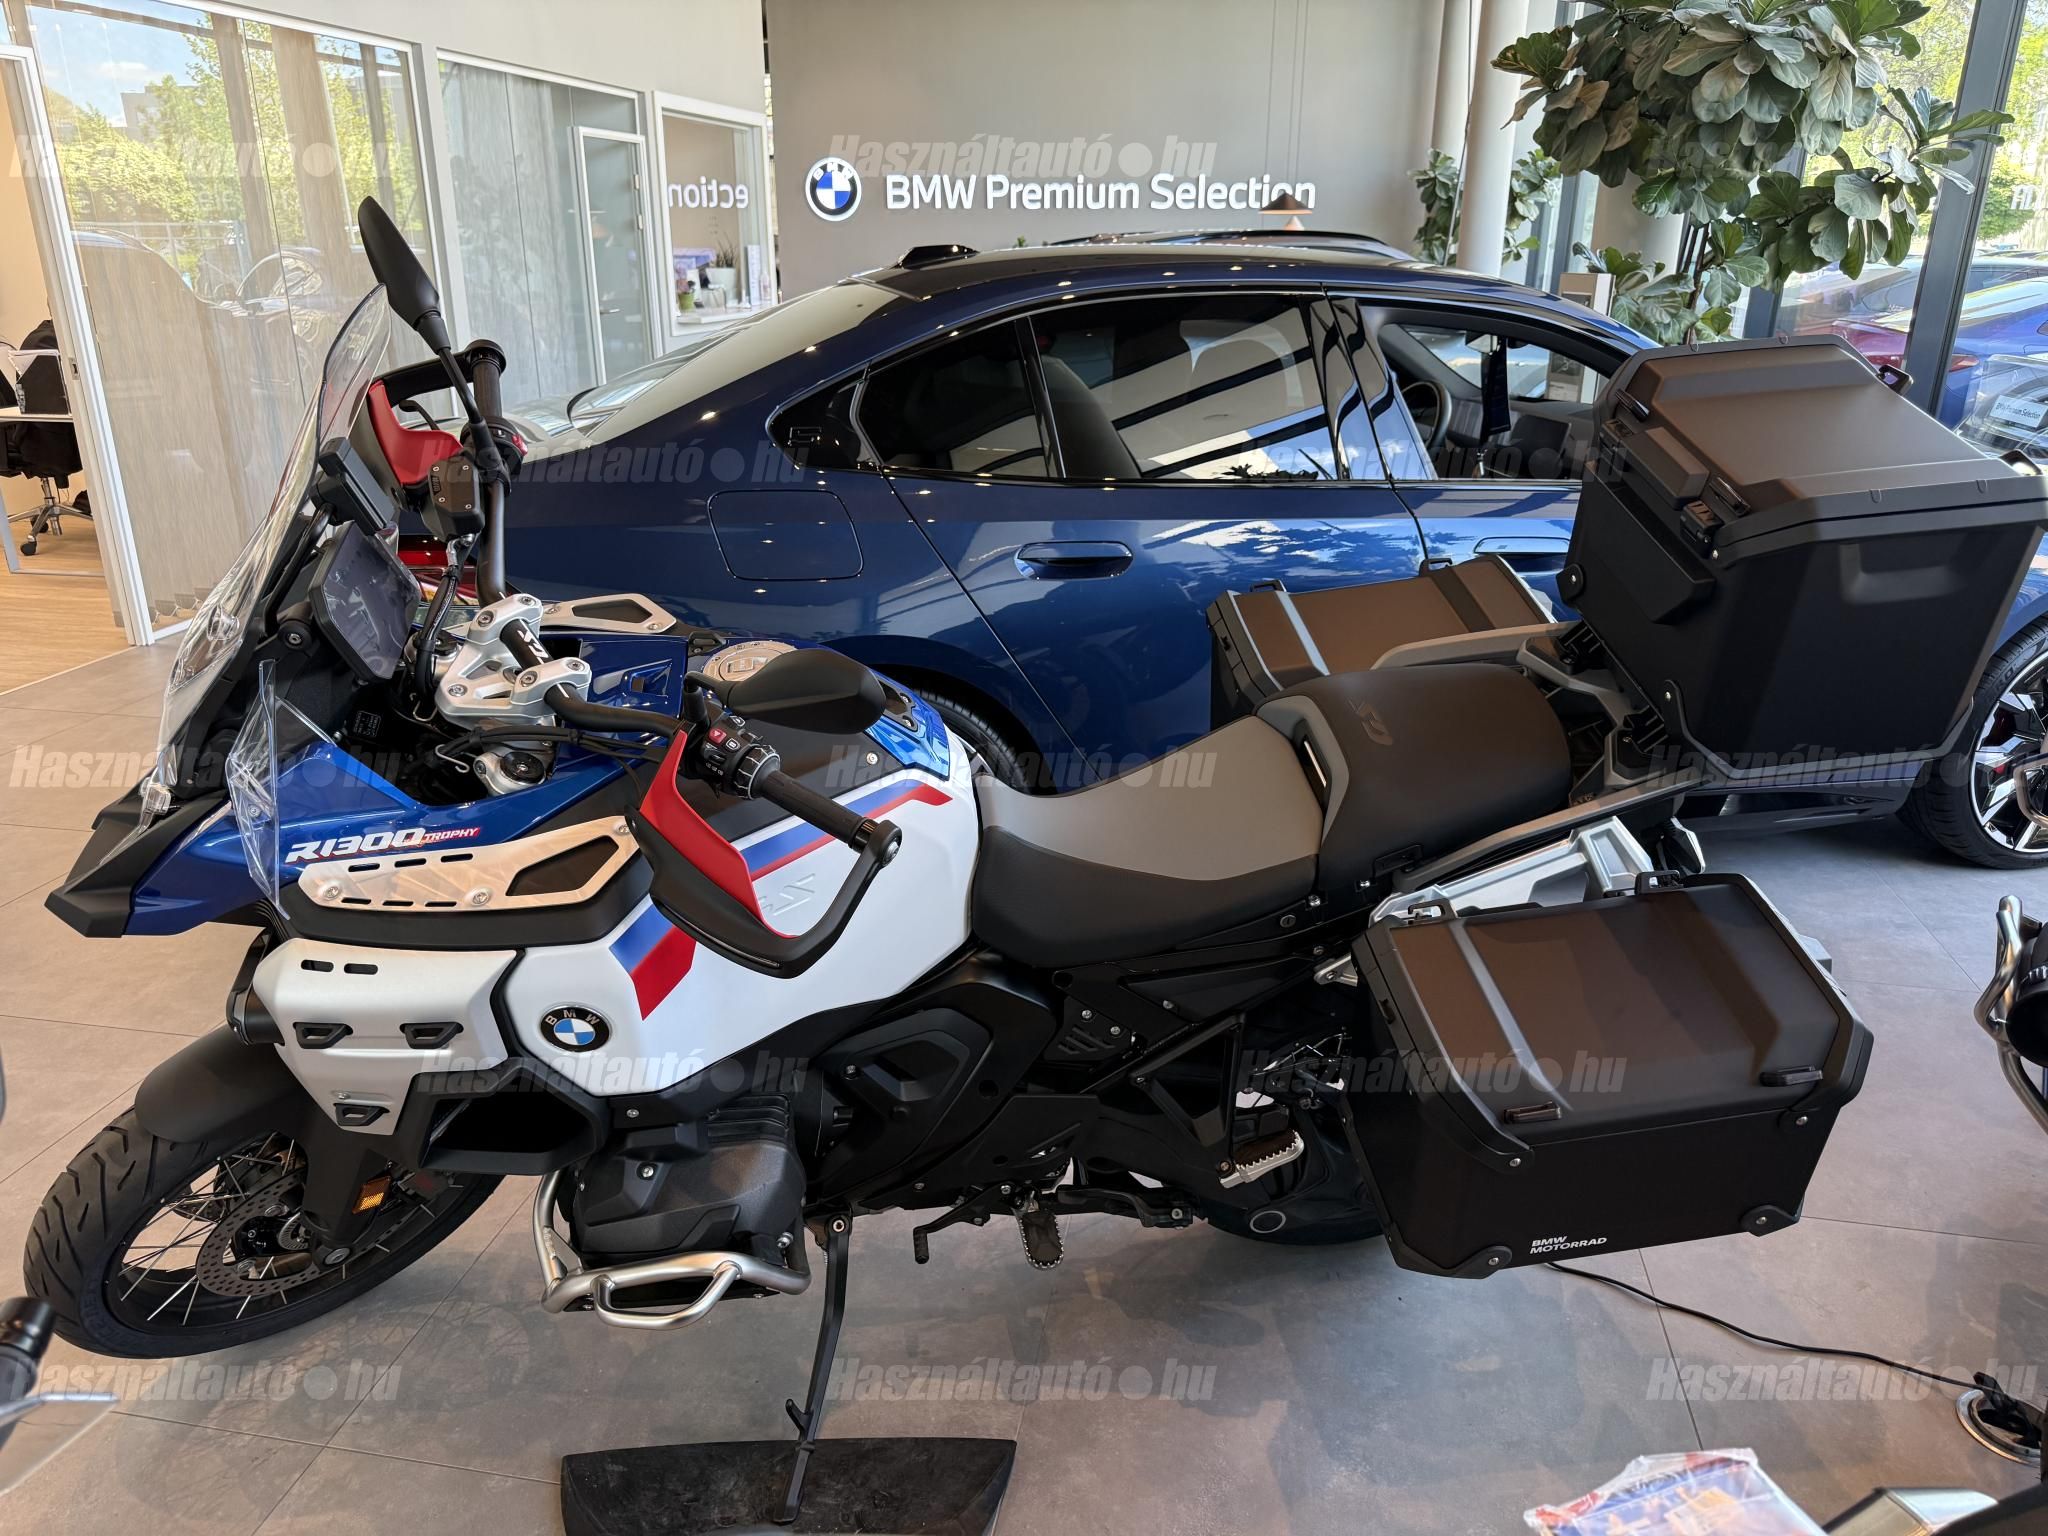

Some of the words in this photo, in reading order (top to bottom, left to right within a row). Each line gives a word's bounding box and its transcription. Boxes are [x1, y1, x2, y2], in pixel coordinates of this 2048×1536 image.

[886, 174, 977, 210] BMW
[985, 174, 1140, 210] Premium
[1150, 172, 1316, 210] Selection
[285, 826, 427, 864] R1300
[423, 827, 479, 842] TROPHY
[545, 1009, 600, 1026] BMW
[1529, 1237, 1608, 1255] MOTORRAD
[1531, 1235, 1568, 1247] BMW
